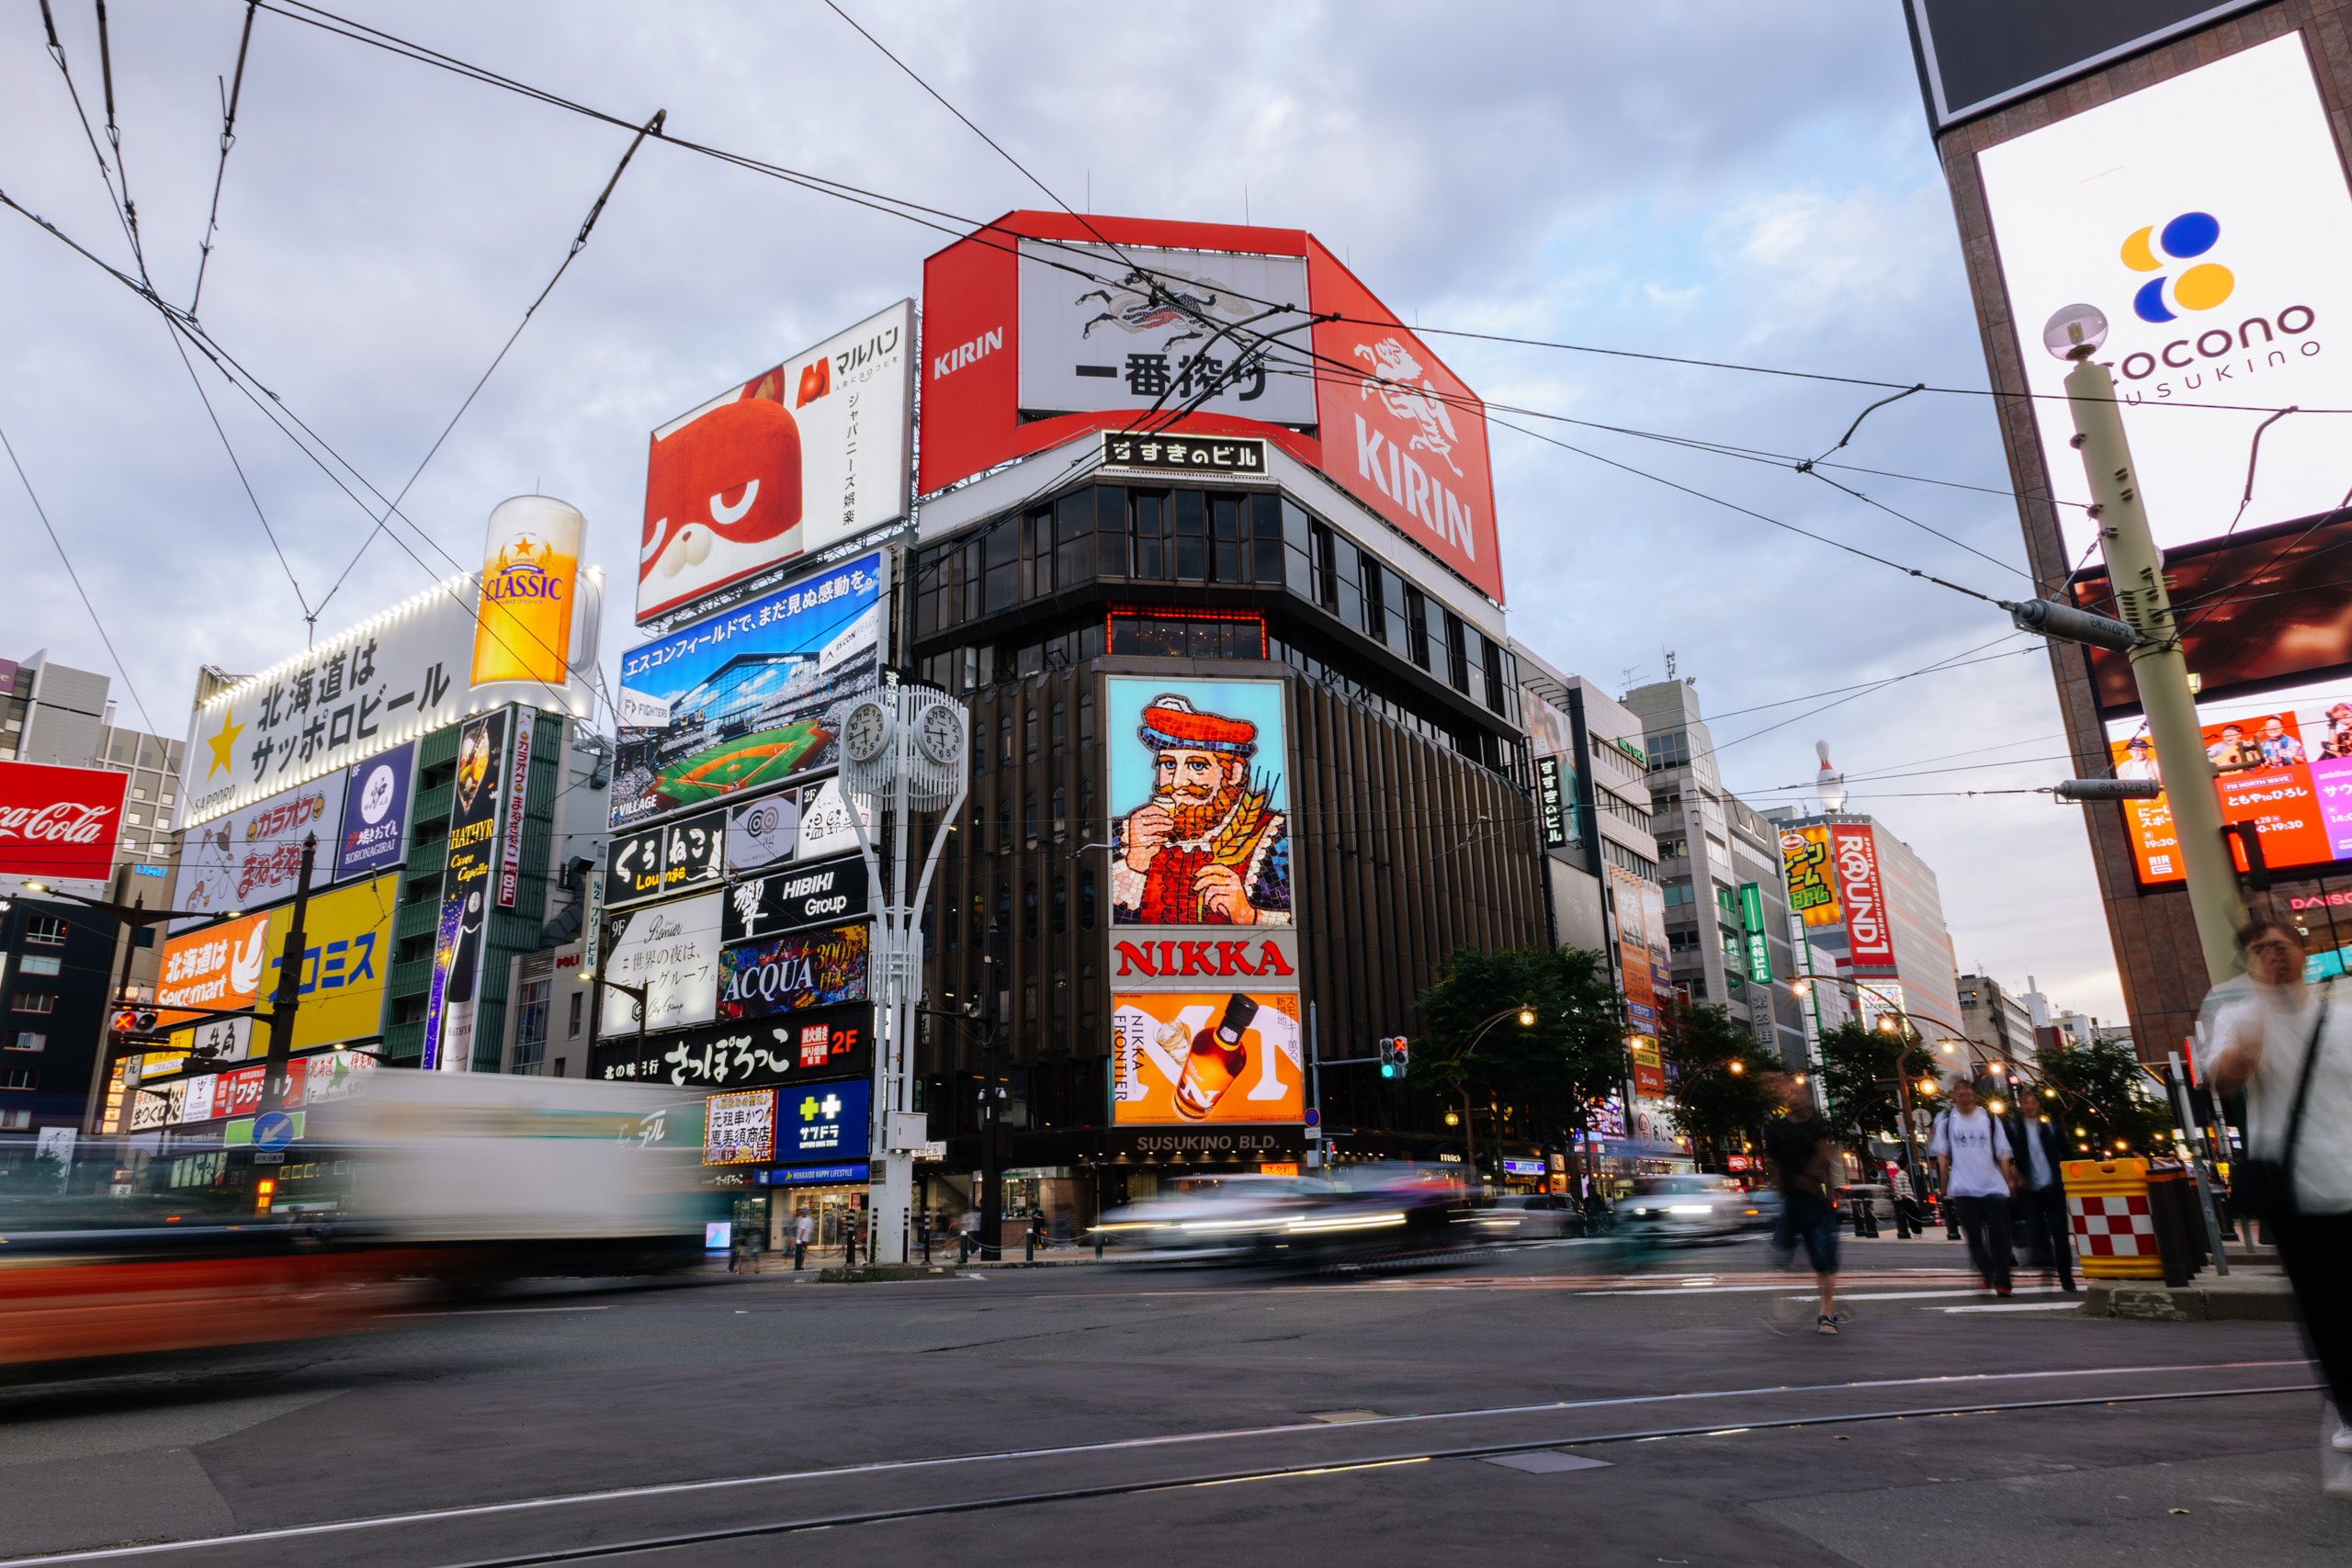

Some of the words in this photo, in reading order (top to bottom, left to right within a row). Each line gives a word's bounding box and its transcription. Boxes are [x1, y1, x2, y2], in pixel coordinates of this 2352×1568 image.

[836, 326, 899, 376] マルハン
[934, 326, 1002, 380] KIRIN
[2103, 305, 2315, 386] ocono
[834, 356, 898, 390] 人生にヨロコビを
[1075, 353, 1267, 401] 一番搾り
[842, 392, 860, 525] ジャパニーズ娯楽
[1113, 440, 1258, 467] すすきのビル
[1354, 412, 1476, 562] KIRIN
[485, 575, 563, 602] CLASSIC
[626, 570, 874, 677] エスコンフィールドで、まだ見ぬ感動を。
[257, 637, 378, 731] 北海道は
[252, 661, 450, 784] サッポロビール
[638, 702, 668, 719] FIGHTERS
[350, 764, 361, 778] 8F
[514, 739, 530, 784] カラオケ
[2318, 770, 2352, 780] ambitiou
[2238, 779, 2264, 789] NORTH
[2266, 775, 2290, 784] WAVE
[195, 784, 236, 811] SAPPORO
[619, 795, 657, 816] VILLAGE
[804, 789, 817, 804] 2F
[2227, 786, 2308, 807] ともやtoひろし
[255, 796, 314, 839] カラオケ
[507, 795, 524, 858] まねきねこ
[449, 818, 494, 851] HATHYR
[345, 839, 396, 865] KORONAGIRAI
[616, 828, 706, 883] くろねこ
[2149, 854, 2171, 866] AIR
[238, 836, 319, 901] まねきね
[636, 866, 686, 891] Lounge
[502, 874, 516, 901] 8F
[783, 872, 834, 900] HIBIKI
[1838, 835, 1889, 954] ROUND1
[1863, 837, 1874, 871] SPORTS
[1869, 870, 1887, 943] ENTERTAINMENT
[805, 895, 847, 917] Group
[587, 906, 601, 966] グリーンビル
[612, 919, 626, 939] 9F
[165, 939, 229, 984] 北海道は
[556, 954, 580, 968] POLI
[814, 938, 861, 971] 300坪
[1114, 940, 1295, 977] NIKKA
[1750, 933, 1769, 980] 美松ビル
[157, 974, 227, 1011] Seicomart
[723, 957, 814, 1003] ACQUA
[802, 1026, 828, 1044] 炭火焼き
[831, 1030, 858, 1055] 2F
[1131, 1015, 1145, 1071] NIKKA
[309, 1056, 334, 1078] 北海道
[665, 1028, 790, 1087] さっぽろっこ
[808, 1056, 820, 1066] 個室
[1114, 1015, 1128, 1101] FRONTIER
[306, 1087, 316, 1102] 1F
[711, 1109, 764, 1128] 元祖串かつ
[799, 1124, 840, 1140] サツドラ
[711, 1125, 770, 1145] 恵美須商店
[799, 1141, 816, 1149] SAPPORO
[816, 1140, 826, 1148] DRUG
[1137, 1135, 1232, 1151] SUSUKINO
[1240, 1134, 1280, 1149] BLD.
[724, 1151, 733, 1161] 1F
[793, 1171, 815, 1179] HOKKAIDO
[816, 1169, 830, 1179] HAPPY
[830, 1168, 854, 1178] LIFESTYLE
